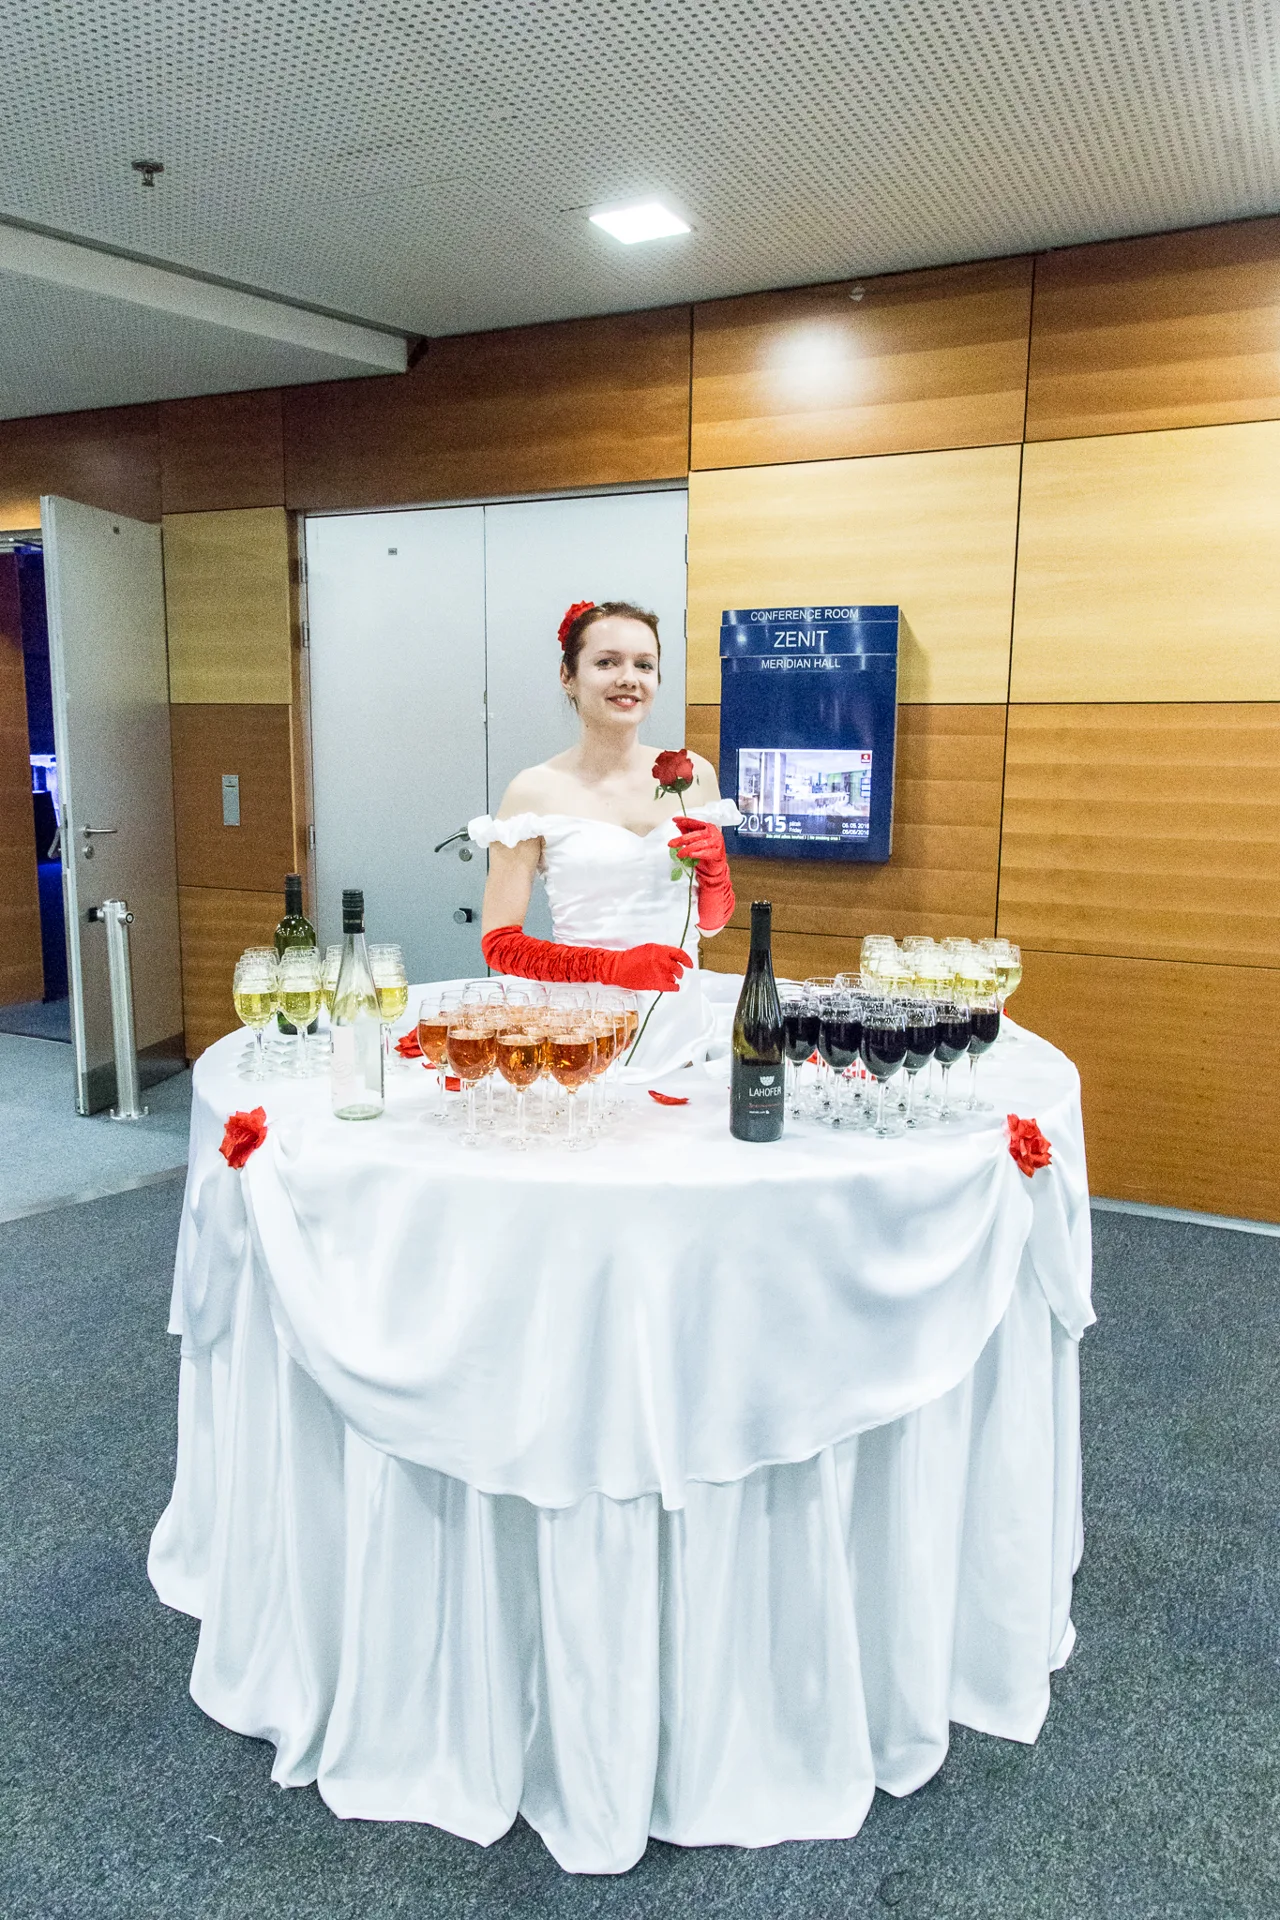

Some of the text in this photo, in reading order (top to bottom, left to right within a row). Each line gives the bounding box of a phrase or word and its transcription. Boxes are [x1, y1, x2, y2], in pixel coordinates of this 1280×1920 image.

[751, 608, 859, 621] CONFERENCE ROOM
[774, 630, 829, 648] ZENIT
[761, 658, 841, 669] MERIDIAN HALL
[737, 815, 787, 833] 20:15
[748, 1086, 782, 1097] LAHOFER
